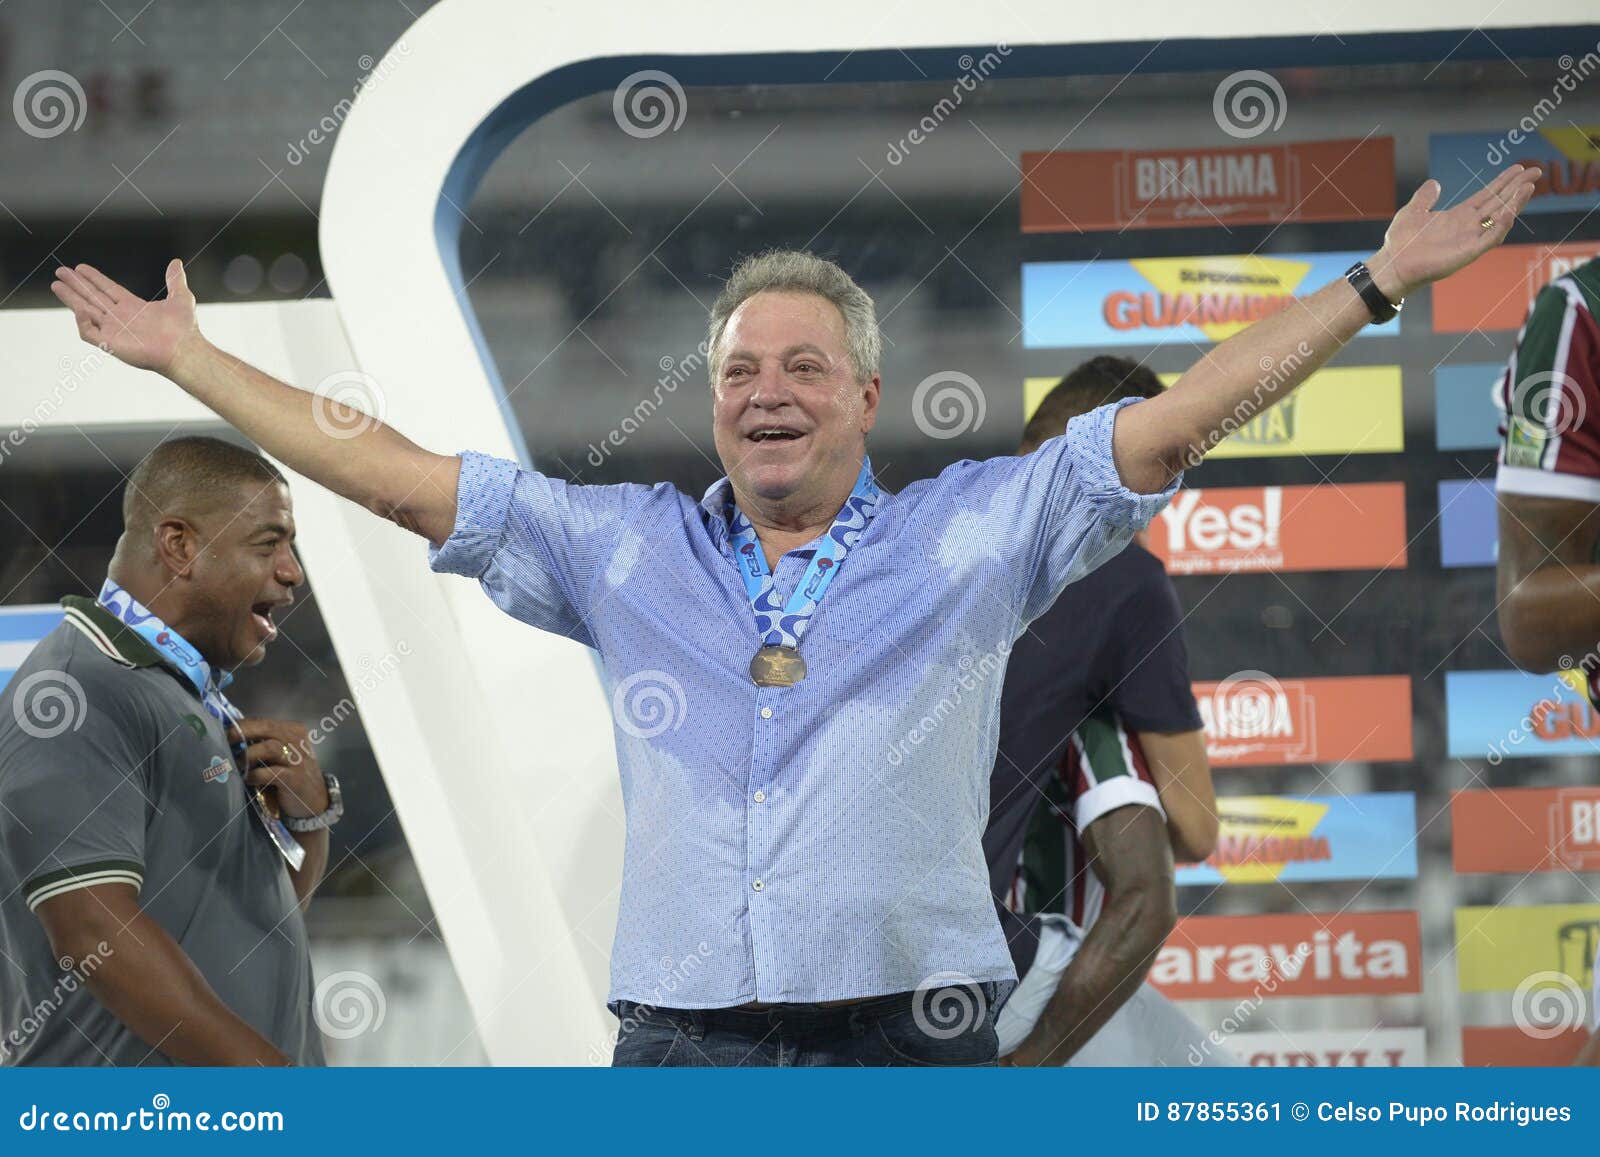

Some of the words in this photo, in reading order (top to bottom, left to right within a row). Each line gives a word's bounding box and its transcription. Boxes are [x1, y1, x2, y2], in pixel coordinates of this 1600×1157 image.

[1135, 152, 1278, 200] BRAHMA
[1160, 486, 1283, 552] Yes!
[1149, 930, 1409, 984] aravita
